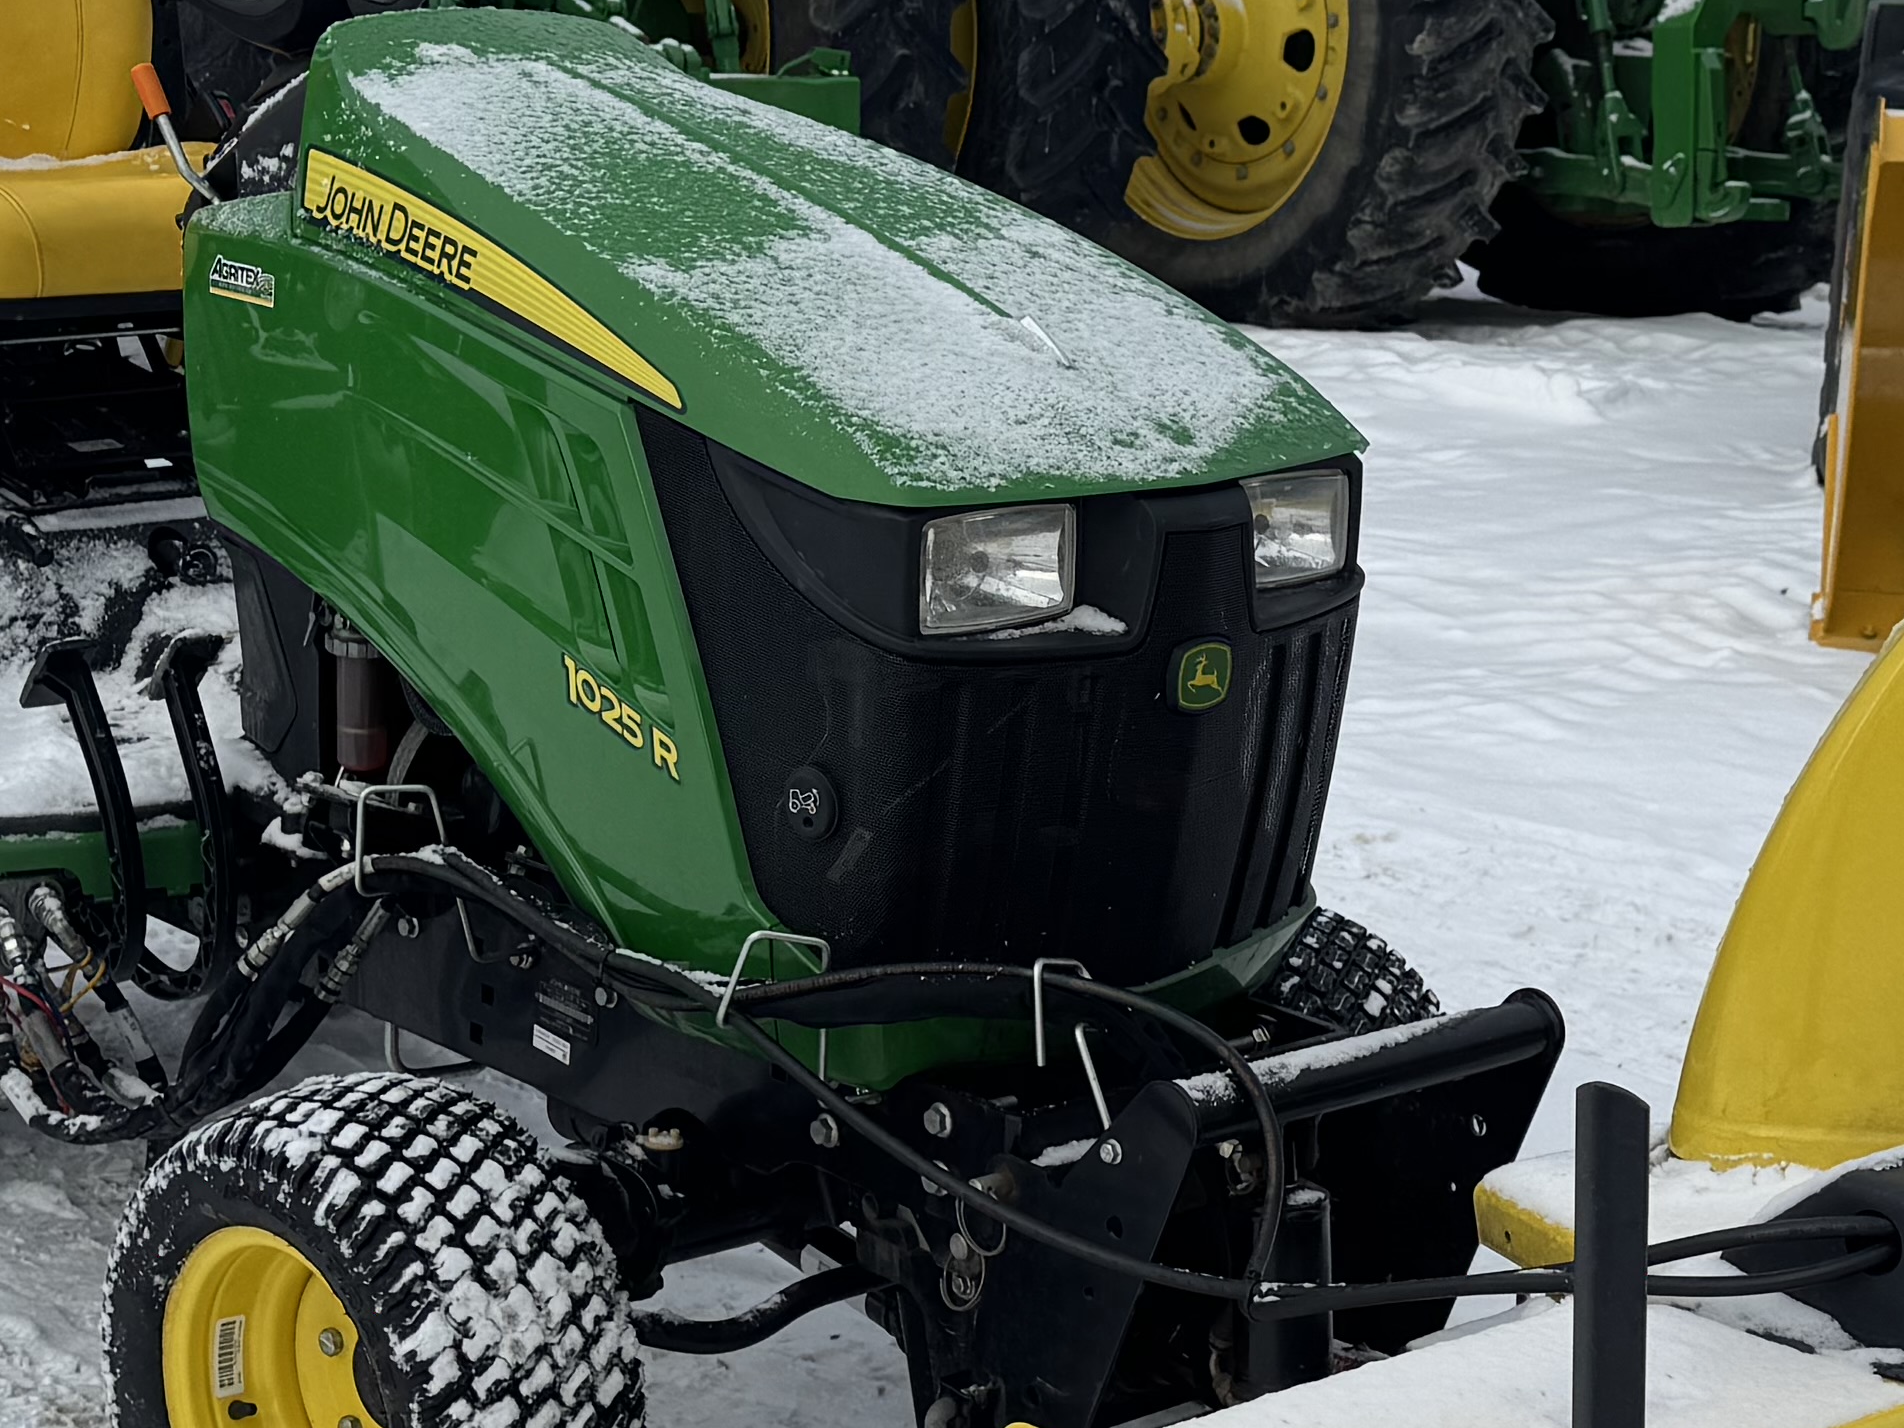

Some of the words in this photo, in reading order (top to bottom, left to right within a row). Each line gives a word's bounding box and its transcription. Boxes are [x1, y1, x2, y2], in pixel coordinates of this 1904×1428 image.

[211, 257, 261, 286] AGRITEX
[315, 175, 384, 238] JOHN
[385, 201, 478, 285] DEERE
[564, 654, 644, 748] 1025
[652, 726, 680, 781] R
